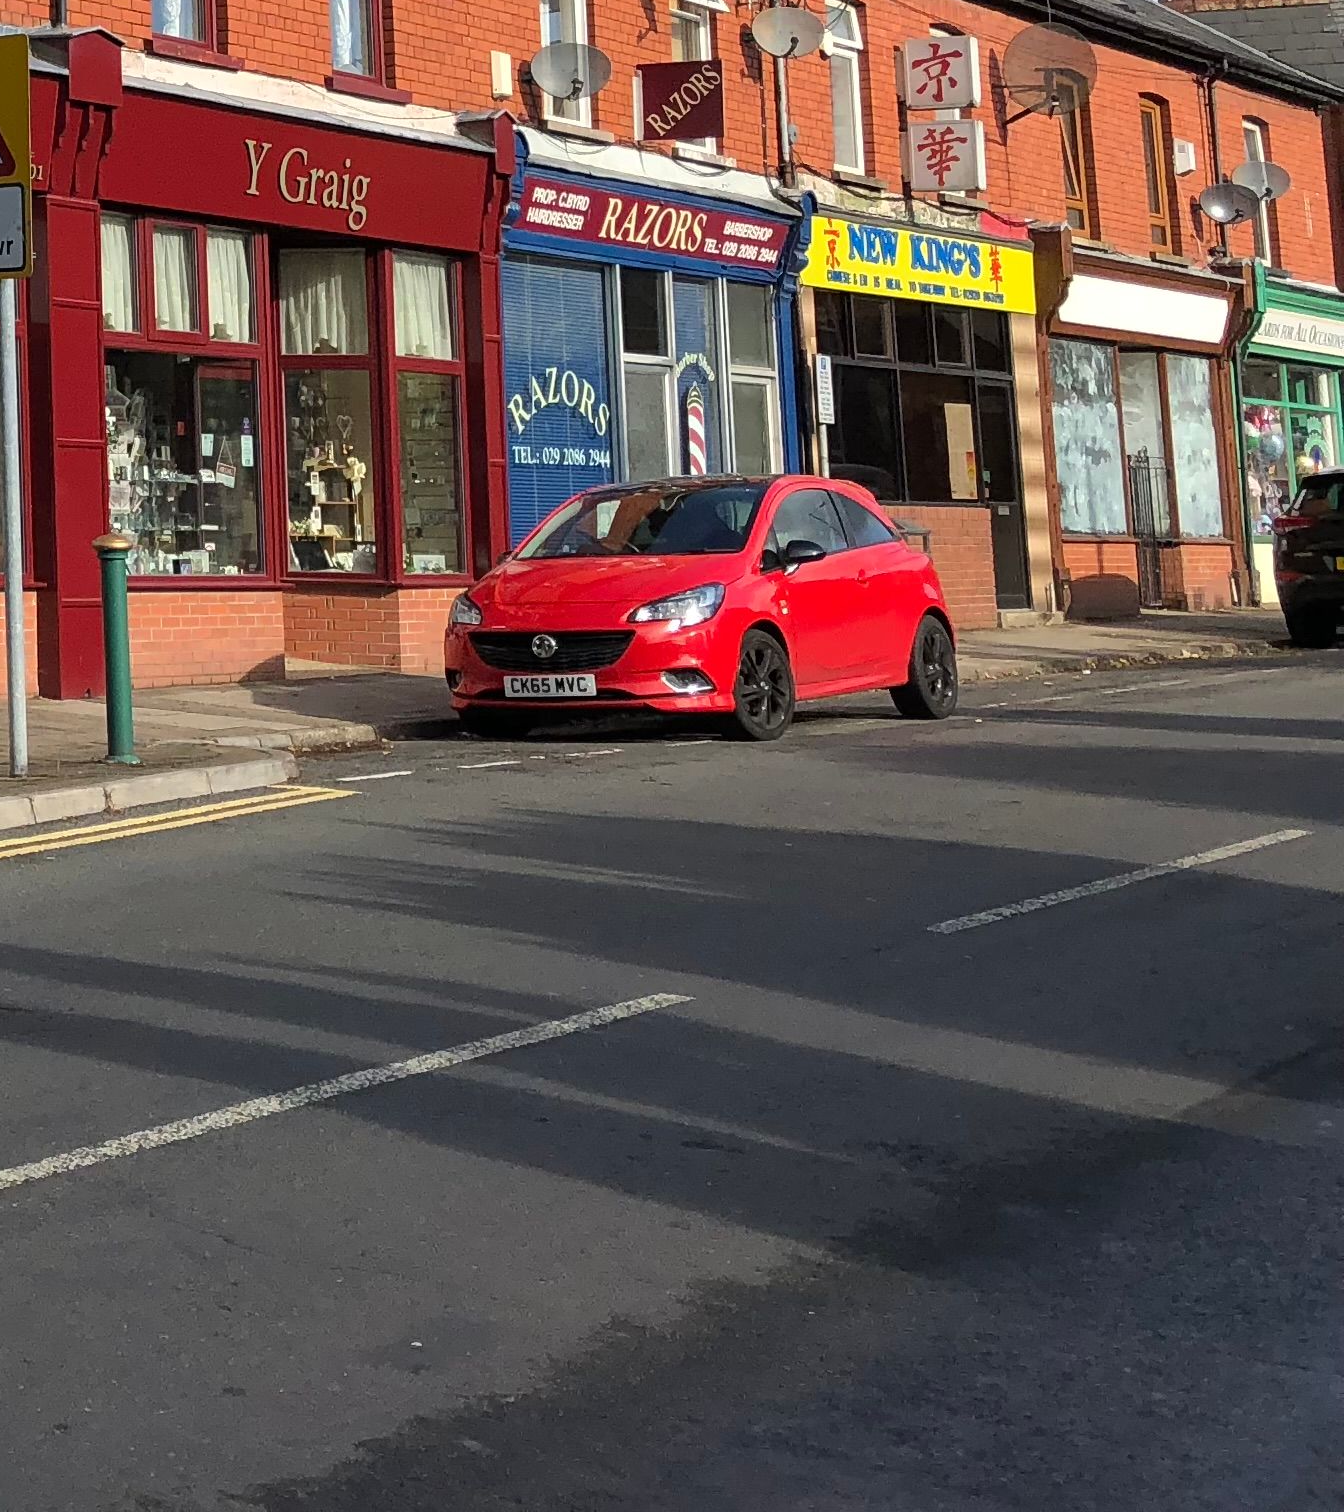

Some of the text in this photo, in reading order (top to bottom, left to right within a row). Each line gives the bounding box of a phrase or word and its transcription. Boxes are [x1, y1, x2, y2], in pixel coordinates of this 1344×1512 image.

[912, 43, 963, 102] 京
[646, 64, 720, 136] RAZORS
[917, 126, 968, 186] 華
[245, 138, 371, 231] Y Graig
[526, 207, 585, 231] HAIRDRESSER
[598, 197, 707, 252] RAZORS
[723, 220, 774, 242] BARBERSHOP
[722, 241, 738, 257] 029
[757, 247, 779, 264] 2944
[847, 224, 981, 278] NEW KING'S
[508, 367, 609, 436] RAZORS
[543, 448, 560, 464] 029
[563, 448, 586, 465] 2086
[589, 450, 610, 468] 2944
[511, 677, 588, 693] CK65 MVC
